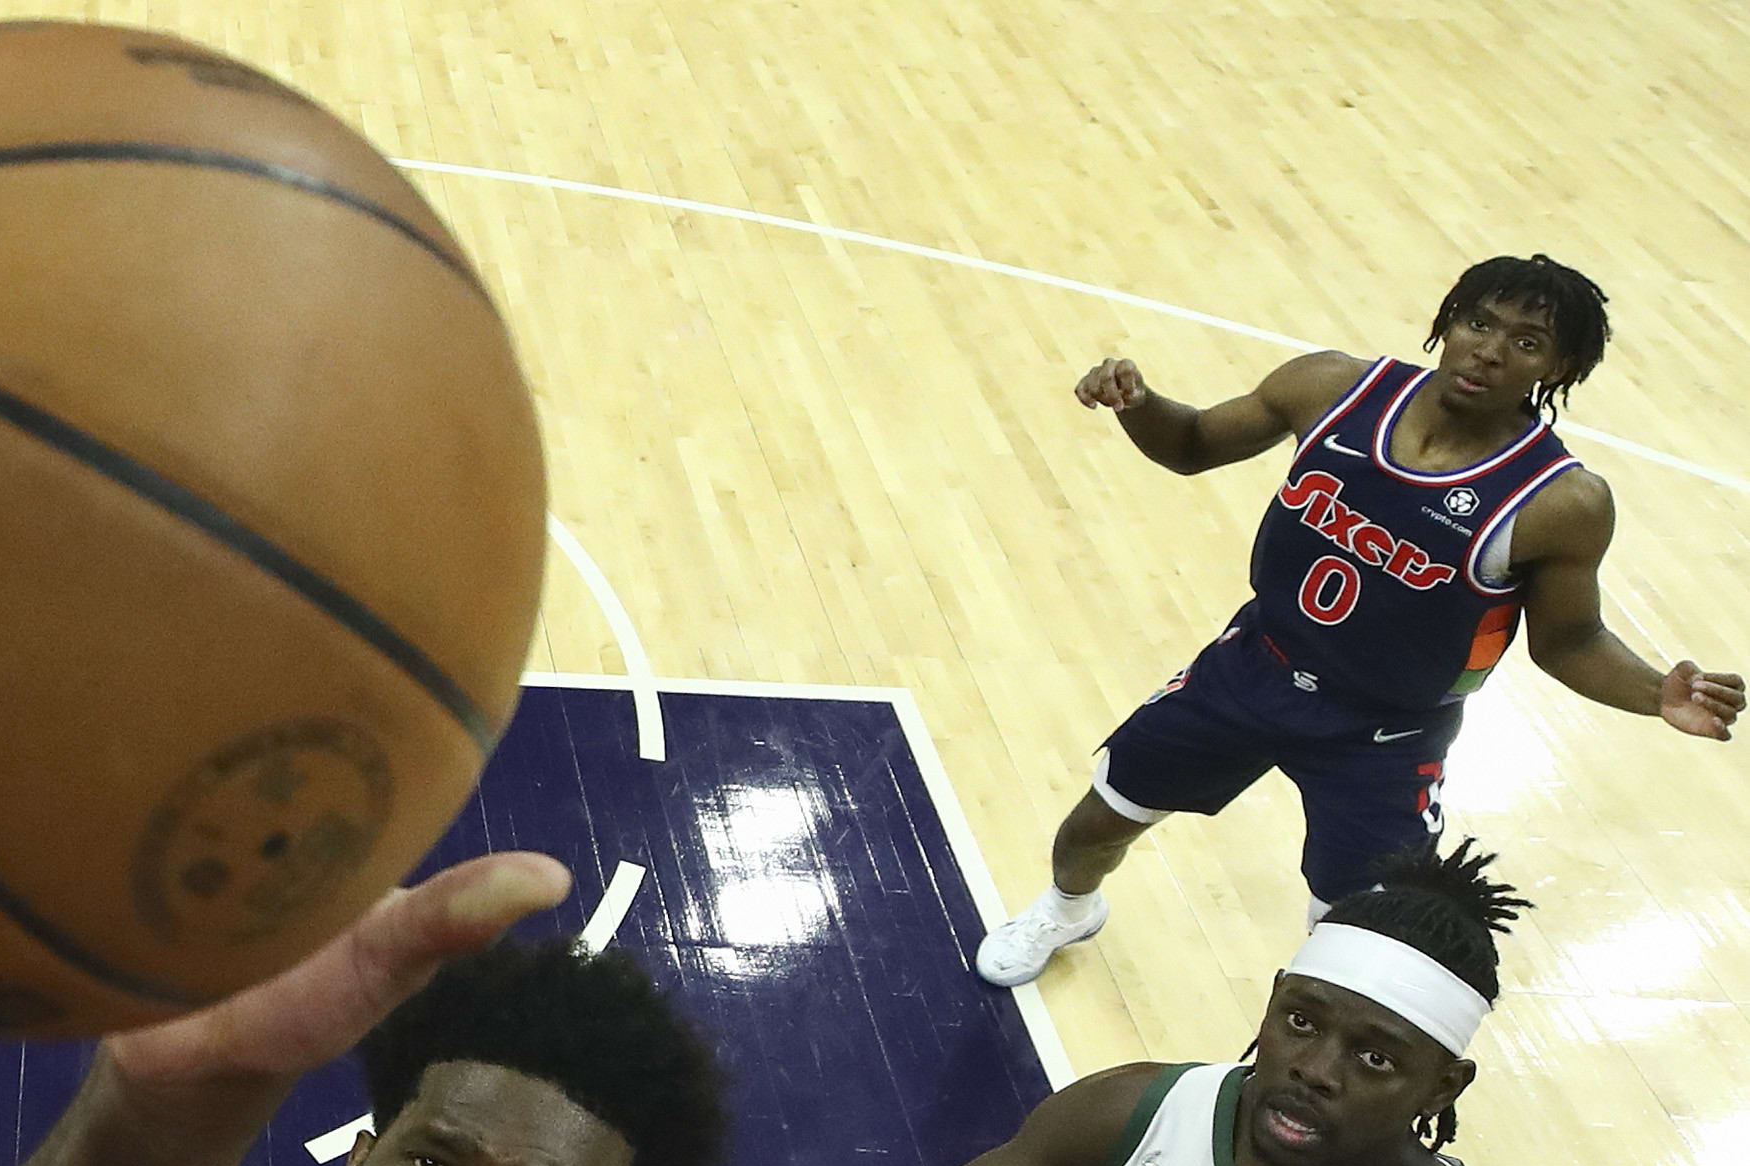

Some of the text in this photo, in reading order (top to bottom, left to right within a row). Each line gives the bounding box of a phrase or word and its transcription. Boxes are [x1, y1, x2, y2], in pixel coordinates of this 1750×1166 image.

[1278, 470, 1457, 590] Sixers
[1421, 505, 1473, 537] crypto.com
[1298, 555, 1361, 625] 0
